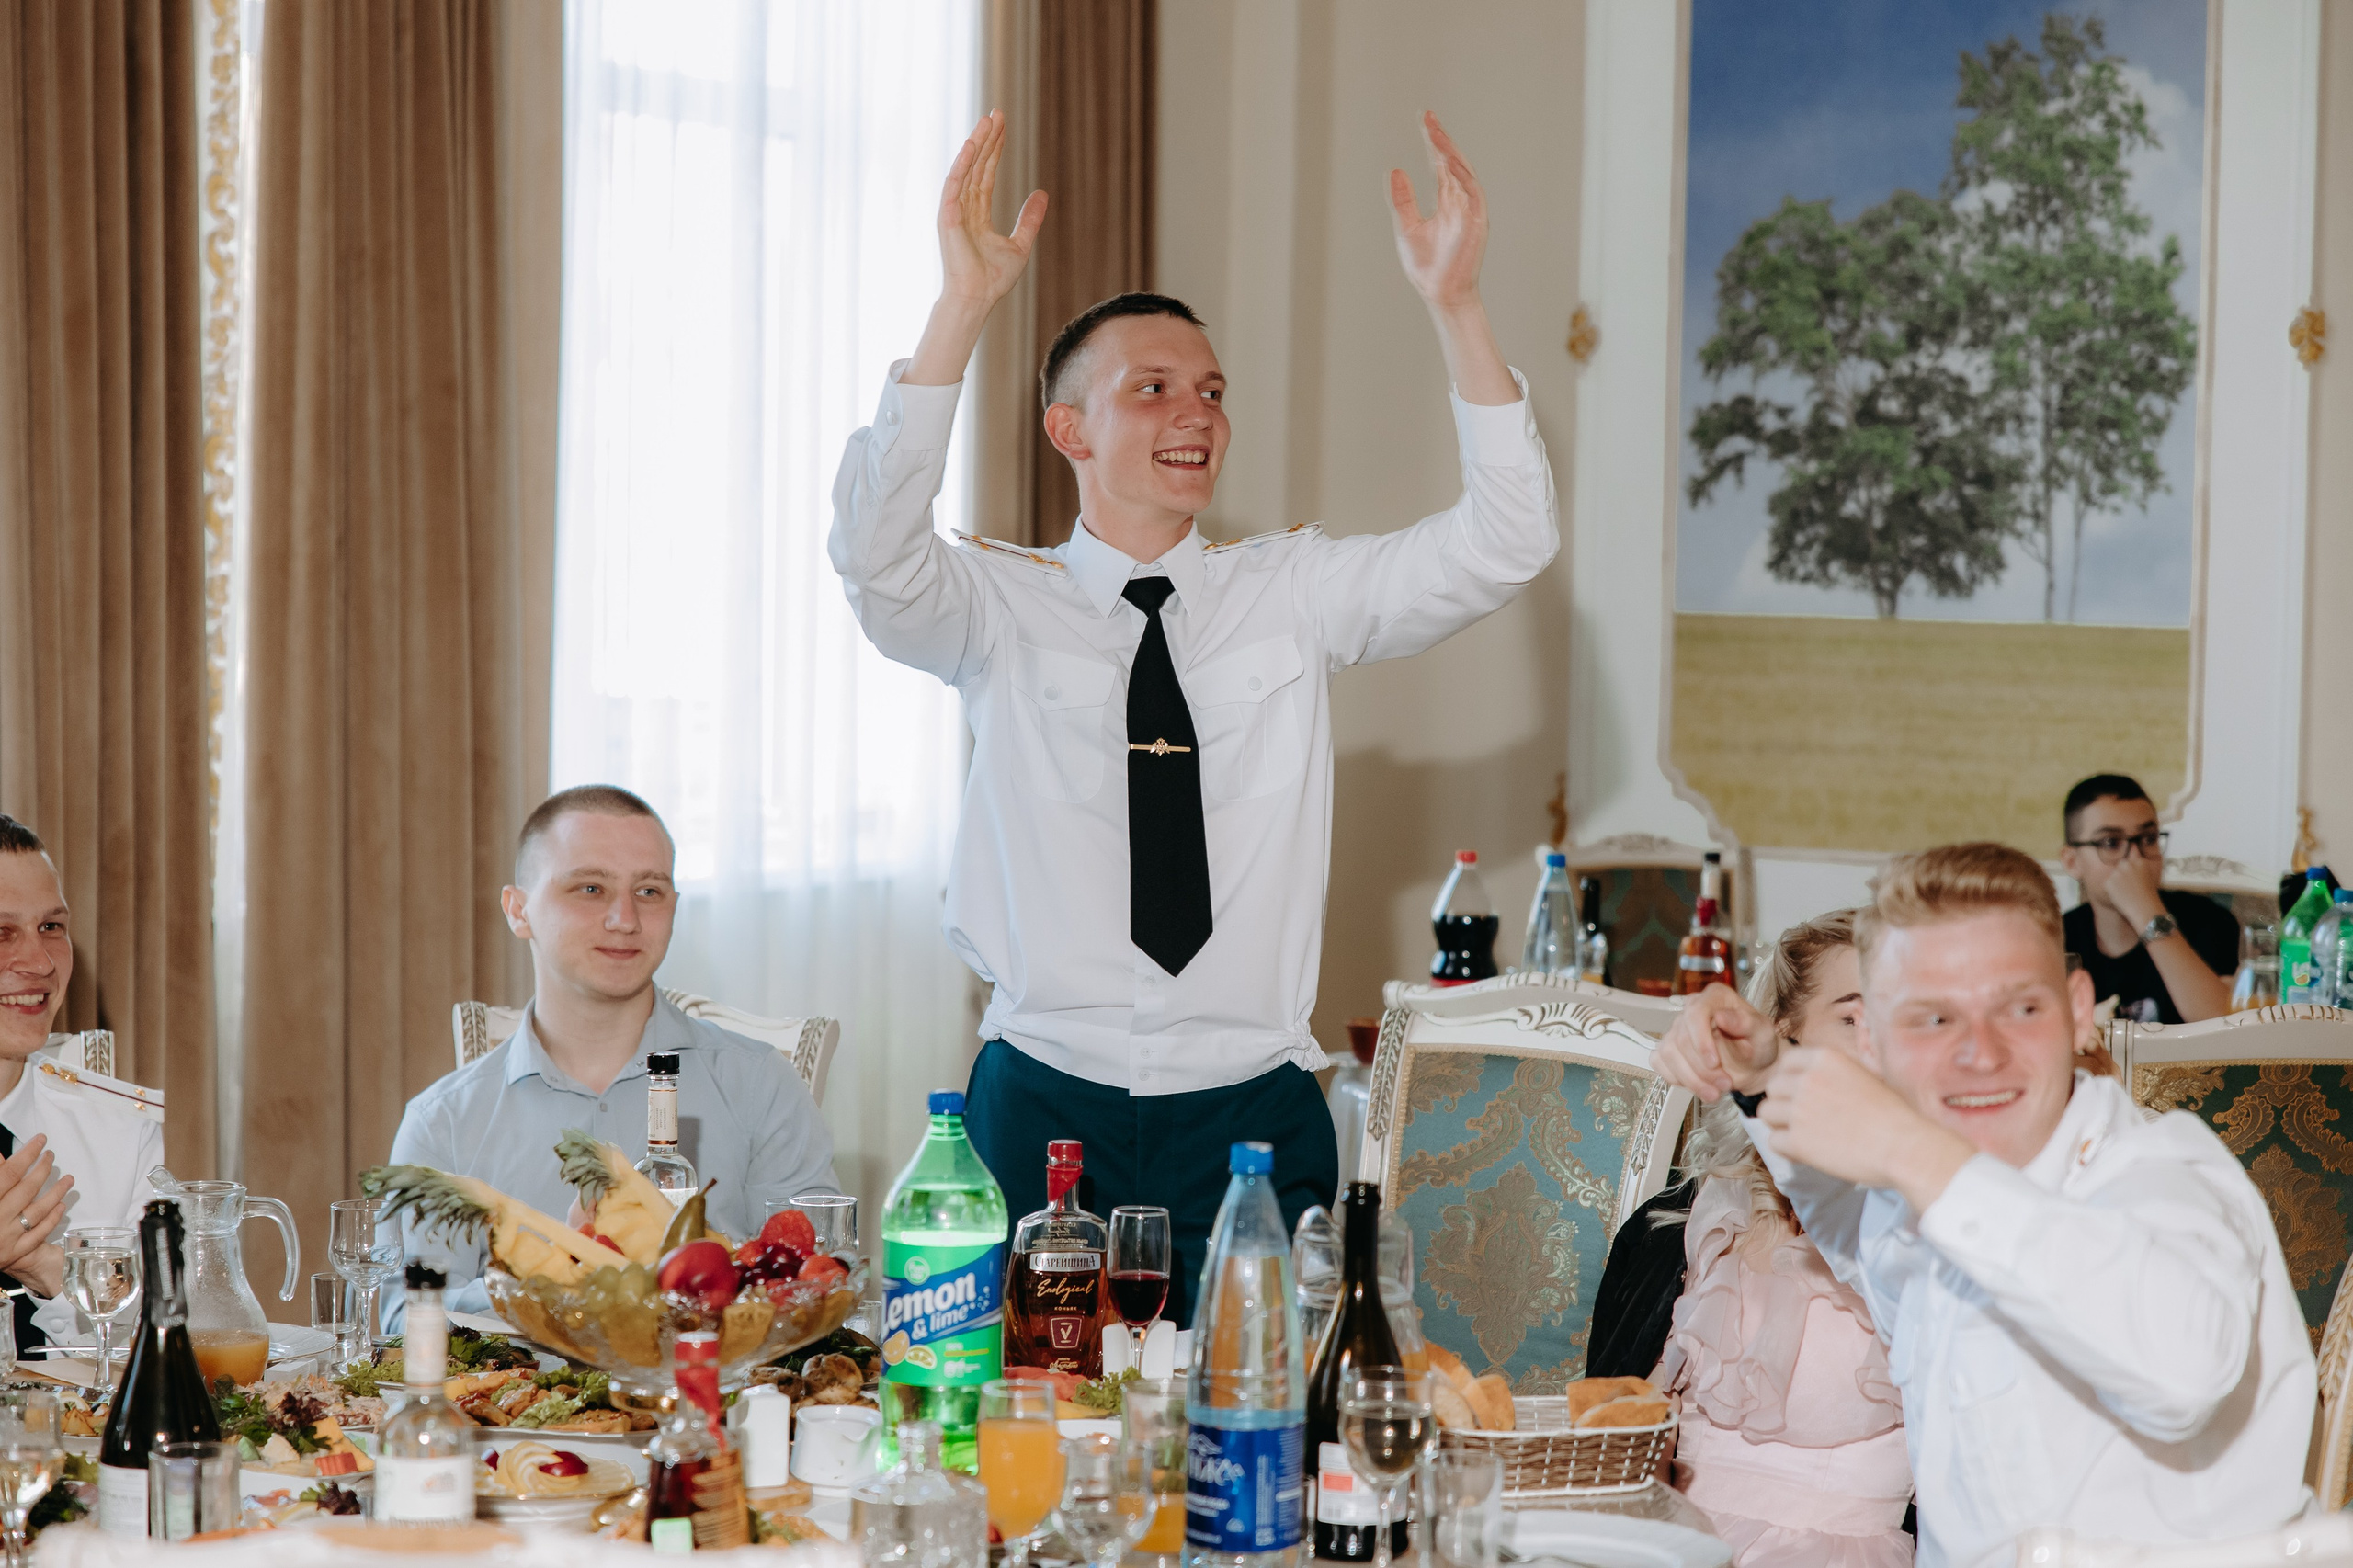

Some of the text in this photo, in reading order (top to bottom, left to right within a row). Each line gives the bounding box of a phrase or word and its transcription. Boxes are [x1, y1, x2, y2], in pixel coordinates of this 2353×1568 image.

[1036, 1277, 1095, 1304] Enological
[911, 1304, 969, 1341] & lime
